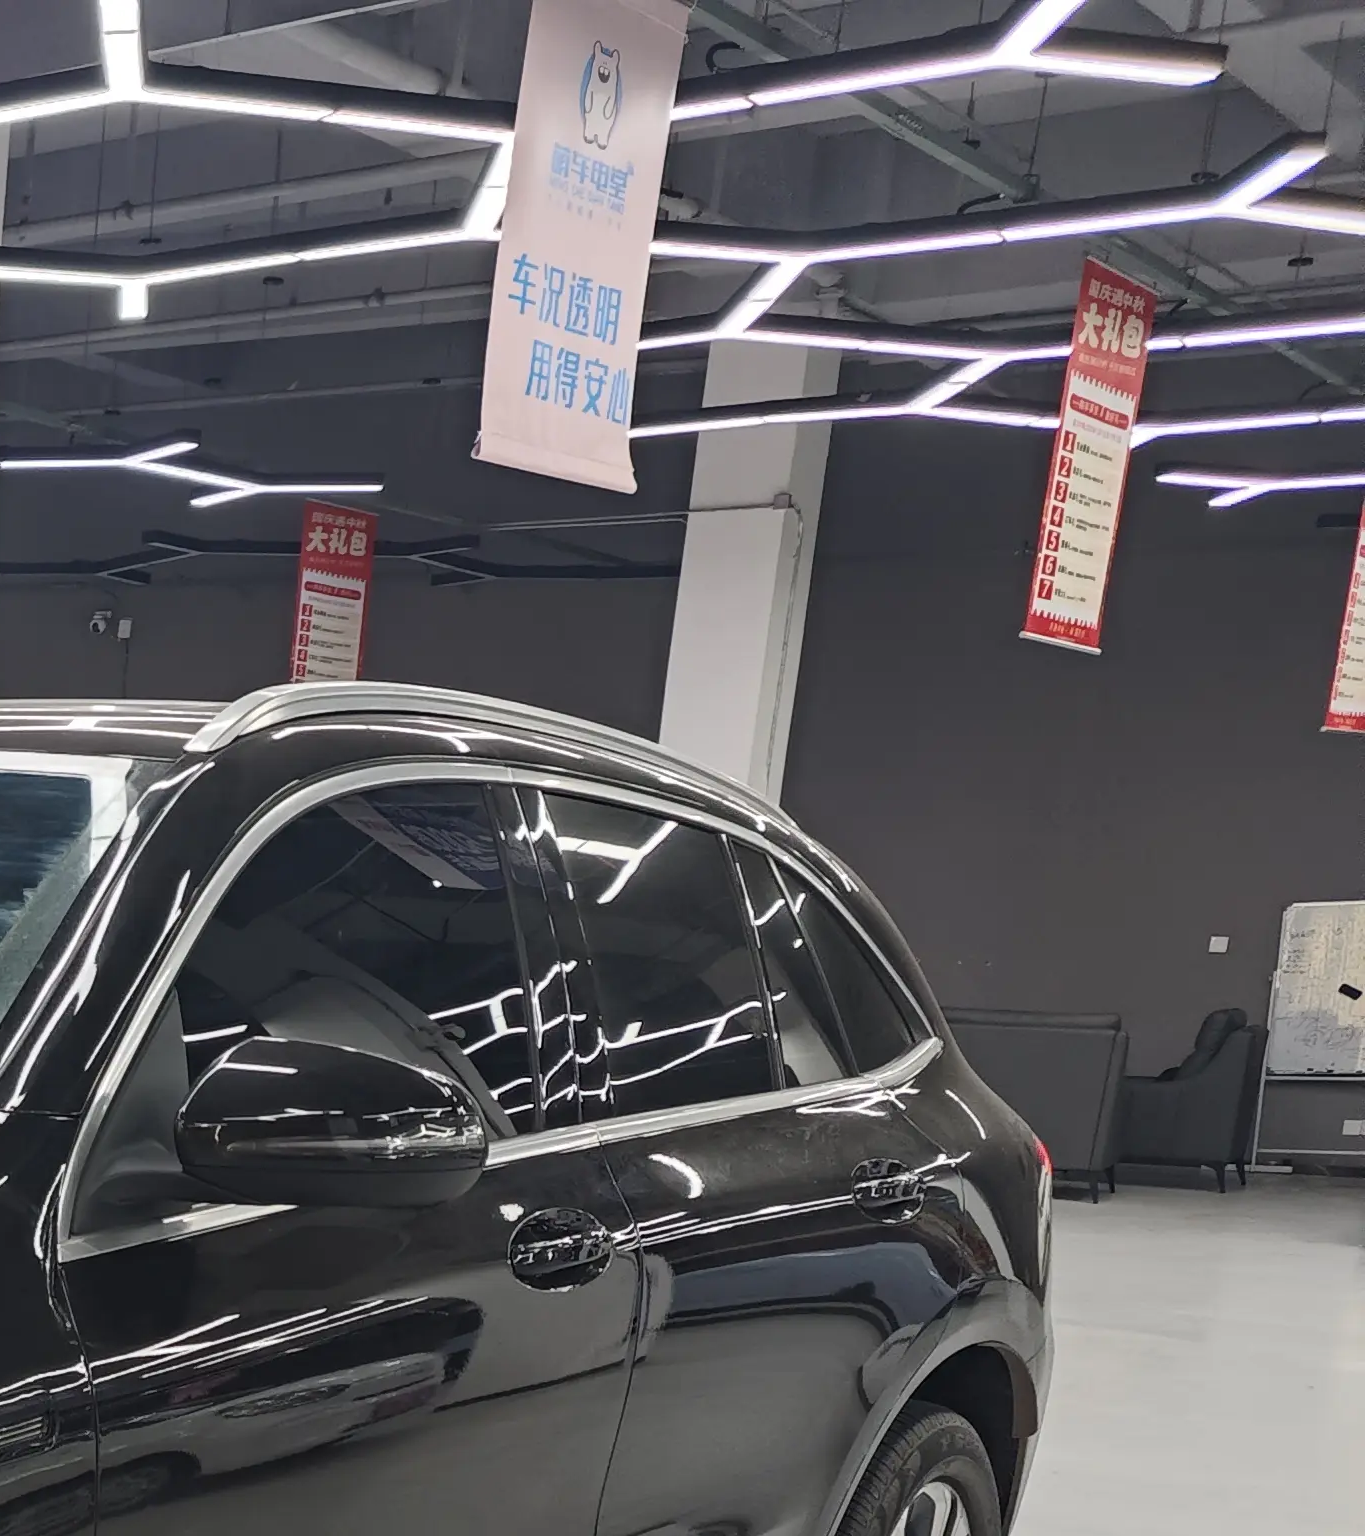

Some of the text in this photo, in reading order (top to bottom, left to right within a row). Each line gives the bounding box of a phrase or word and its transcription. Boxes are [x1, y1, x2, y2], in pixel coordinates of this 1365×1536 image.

[508, 252, 622, 346] 车况透明
[1078, 302, 1145, 359] 大礼包
[525, 338, 630, 426] 用得安心
[305, 525, 367, 557] 大礼包
